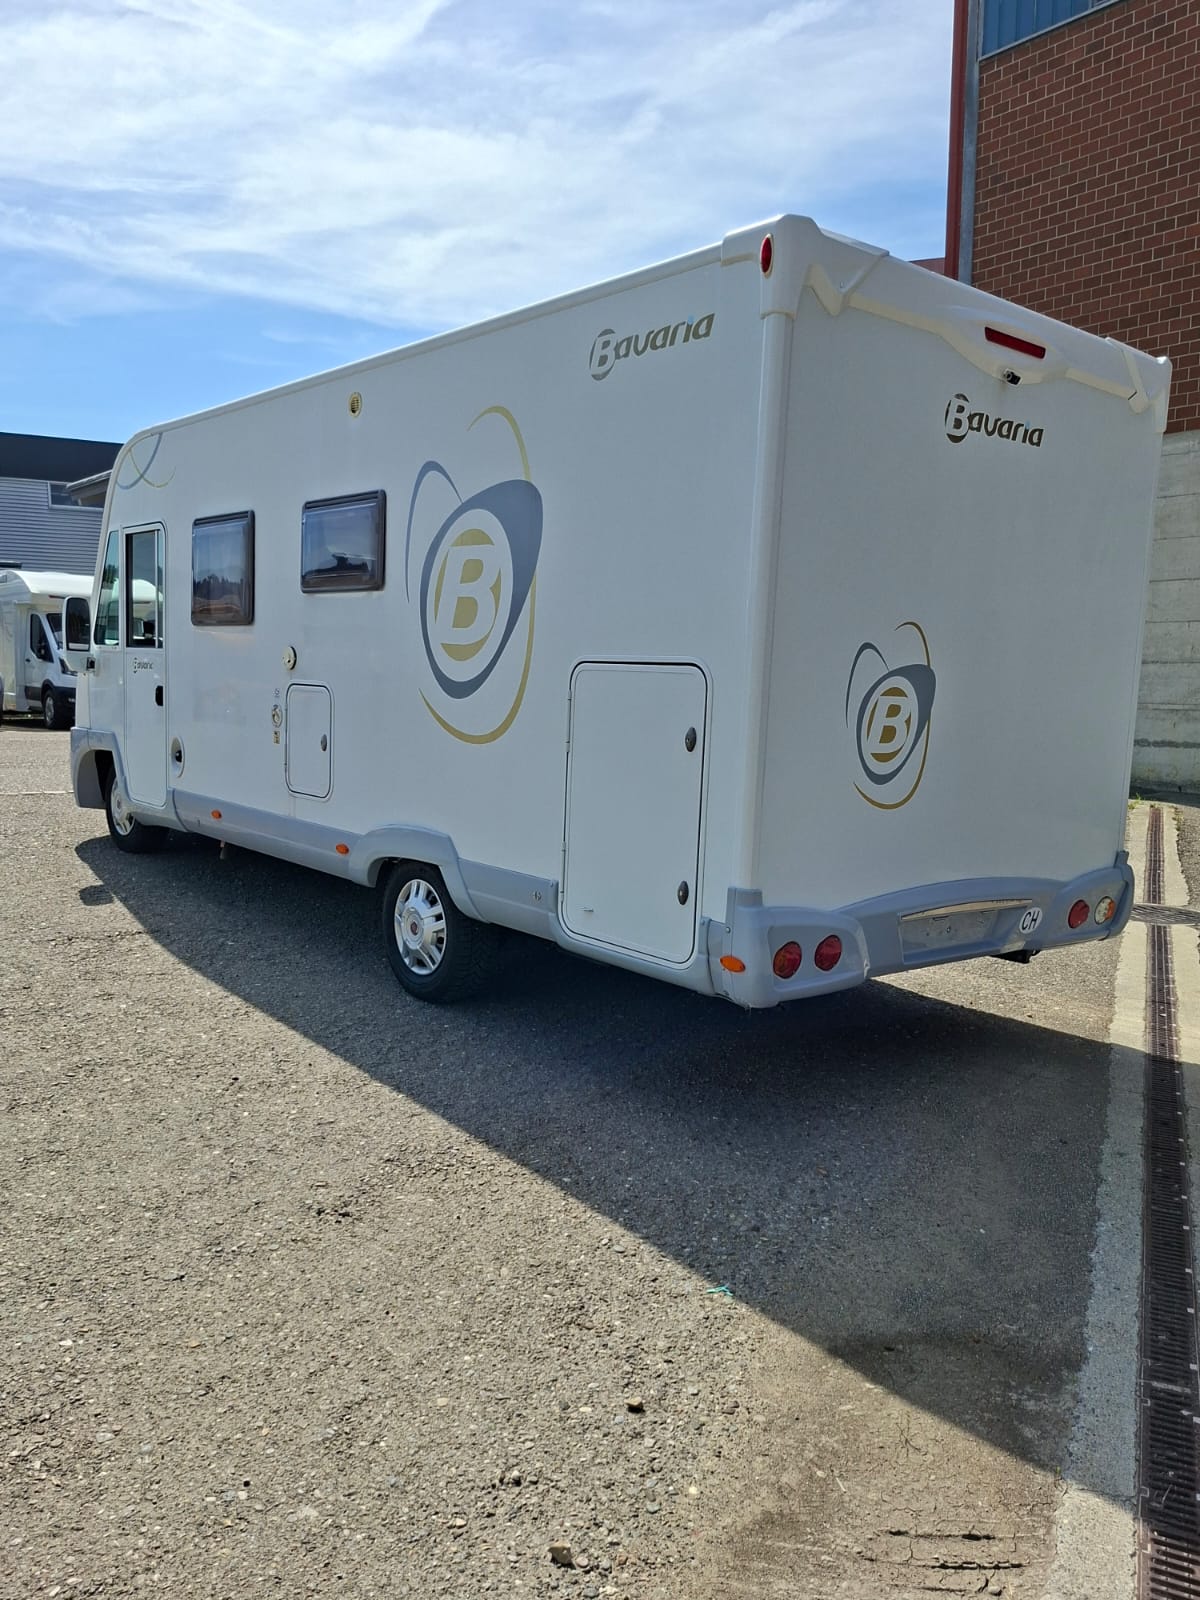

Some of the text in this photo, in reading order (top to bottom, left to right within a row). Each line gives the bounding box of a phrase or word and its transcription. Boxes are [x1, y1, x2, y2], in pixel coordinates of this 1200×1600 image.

[589, 313, 715, 381] Bavaria
[944, 393, 1044, 447] Bavaria
[435, 534, 500, 654] B
[868, 692, 911, 758] B
[1021, 910, 1040, 931] CH
